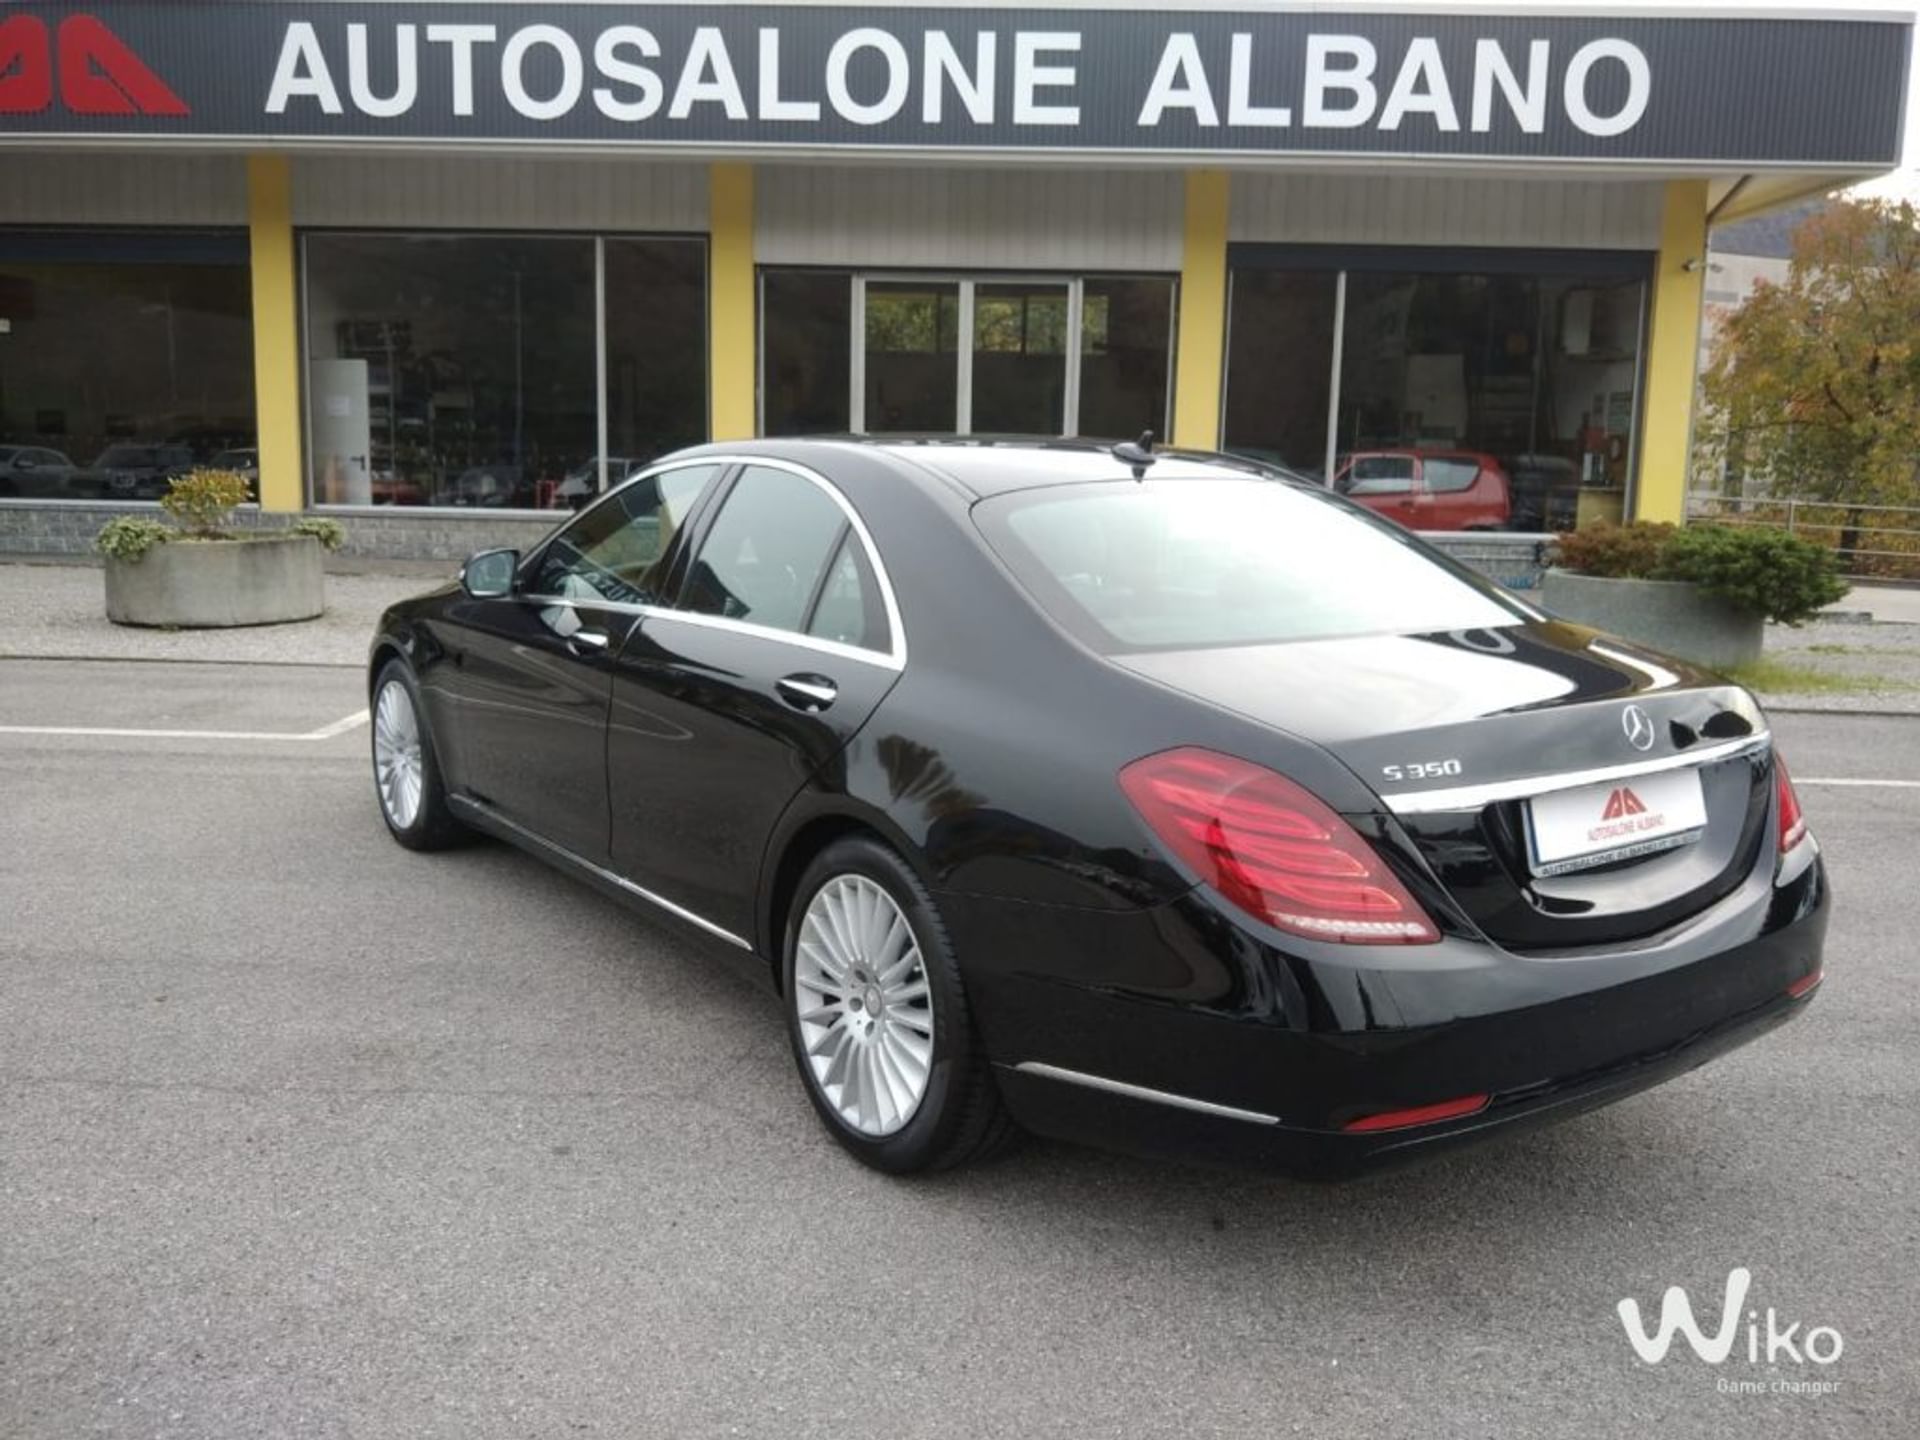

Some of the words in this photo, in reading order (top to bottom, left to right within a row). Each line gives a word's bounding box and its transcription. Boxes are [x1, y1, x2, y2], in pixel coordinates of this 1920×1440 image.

[265, 21, 1082, 127] AUTOSALONE
[1137, 31, 1651, 137] ALBANO
[1382, 765, 1403, 781] S
[1405, 759, 1462, 779] 350
